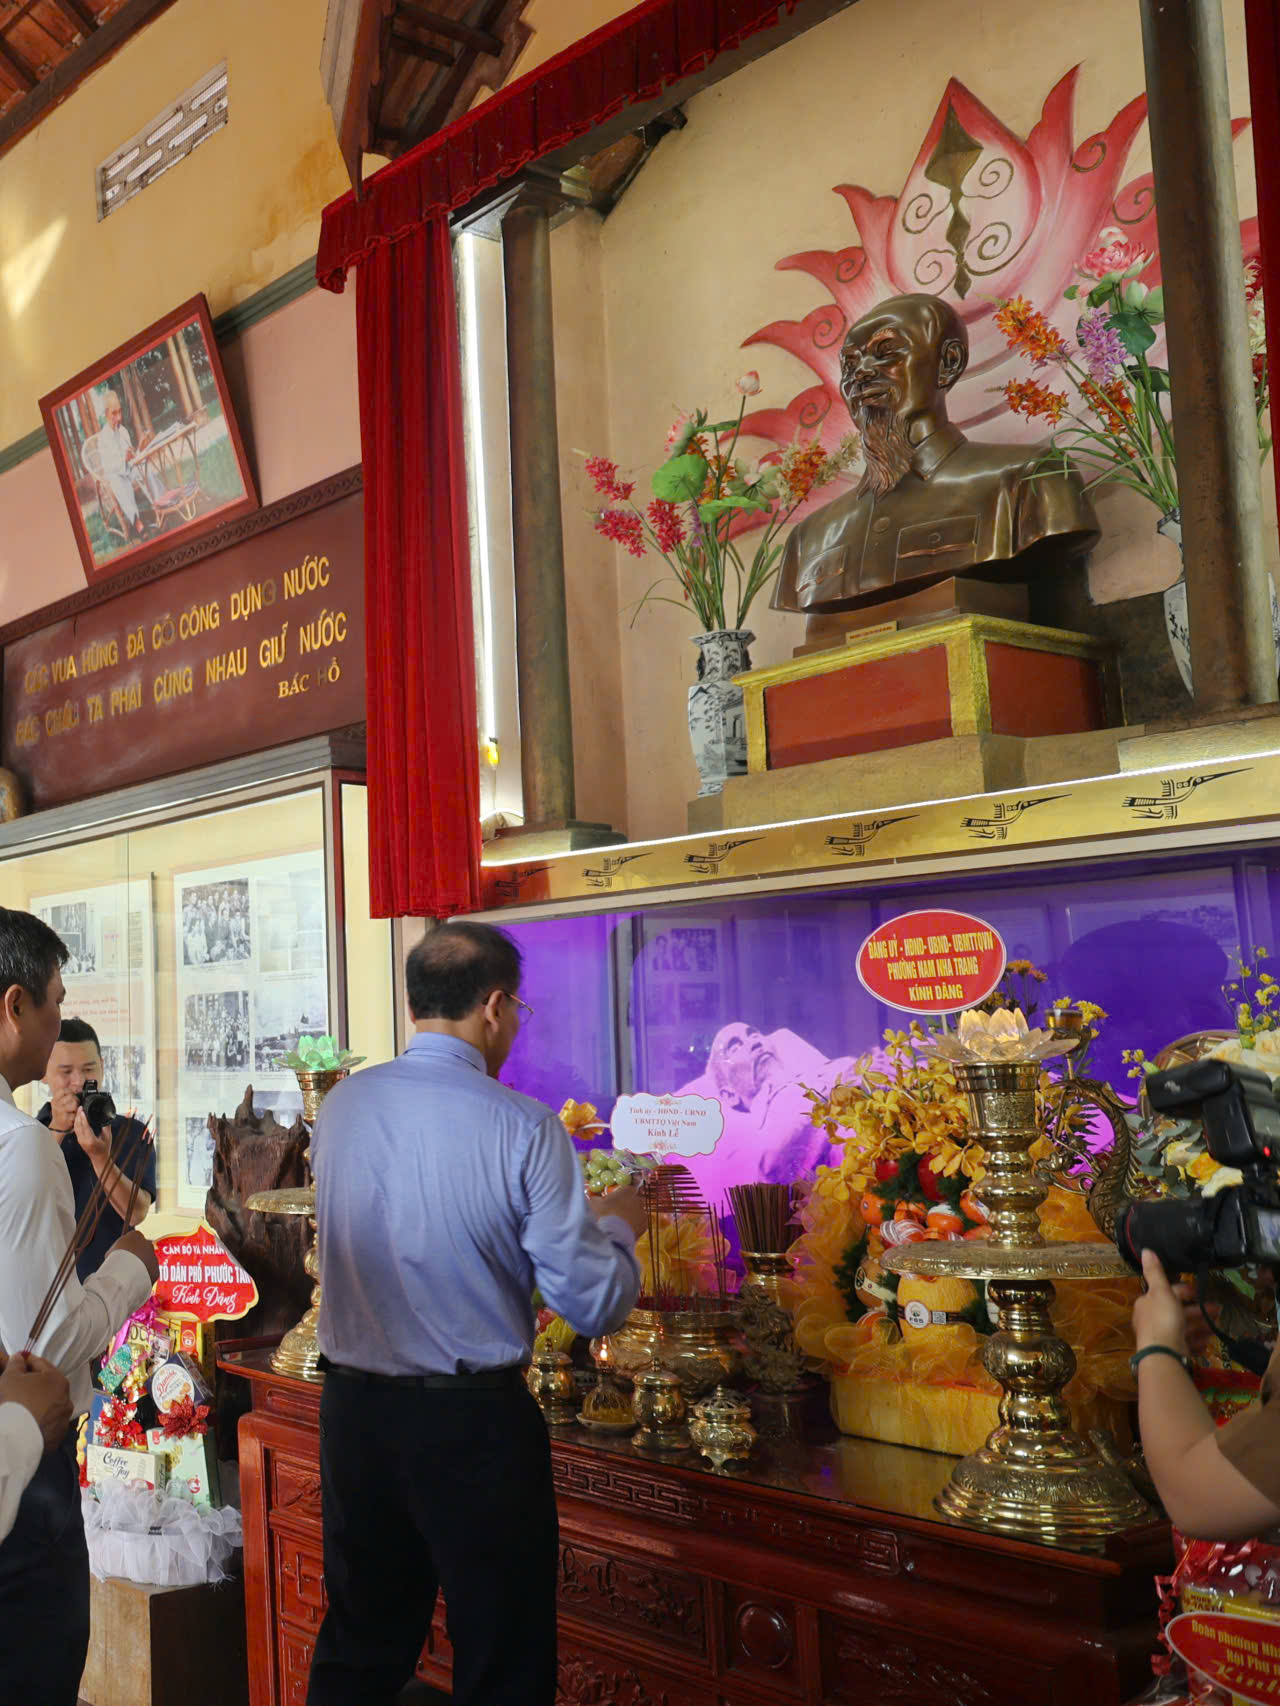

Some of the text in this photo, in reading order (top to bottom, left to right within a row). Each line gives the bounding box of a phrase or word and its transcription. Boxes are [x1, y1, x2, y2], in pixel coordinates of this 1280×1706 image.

[51, 655, 78, 685] VUA
[179, 602, 220, 641] CÔNG
[283, 555, 330, 600] NƯỚC
[87, 694, 104, 725] TA
[153, 667, 193, 704] CÙNG
[205, 646, 247, 686] NHAU
[299, 608, 347, 655] NƯỚC
[278, 672, 310, 698] BÁC
[917, 959, 936, 979] NAM
[936, 957, 954, 977] NHA
[953, 955, 980, 976] TRANG
[909, 981, 964, 1001] KÍNH DÂNG
[170, 1261, 187, 1283] DÂN
[172, 1284, 200, 1304] Kính
[103, 1450, 129, 1467] Coffee
[112, 1465, 130, 1479] Joy
